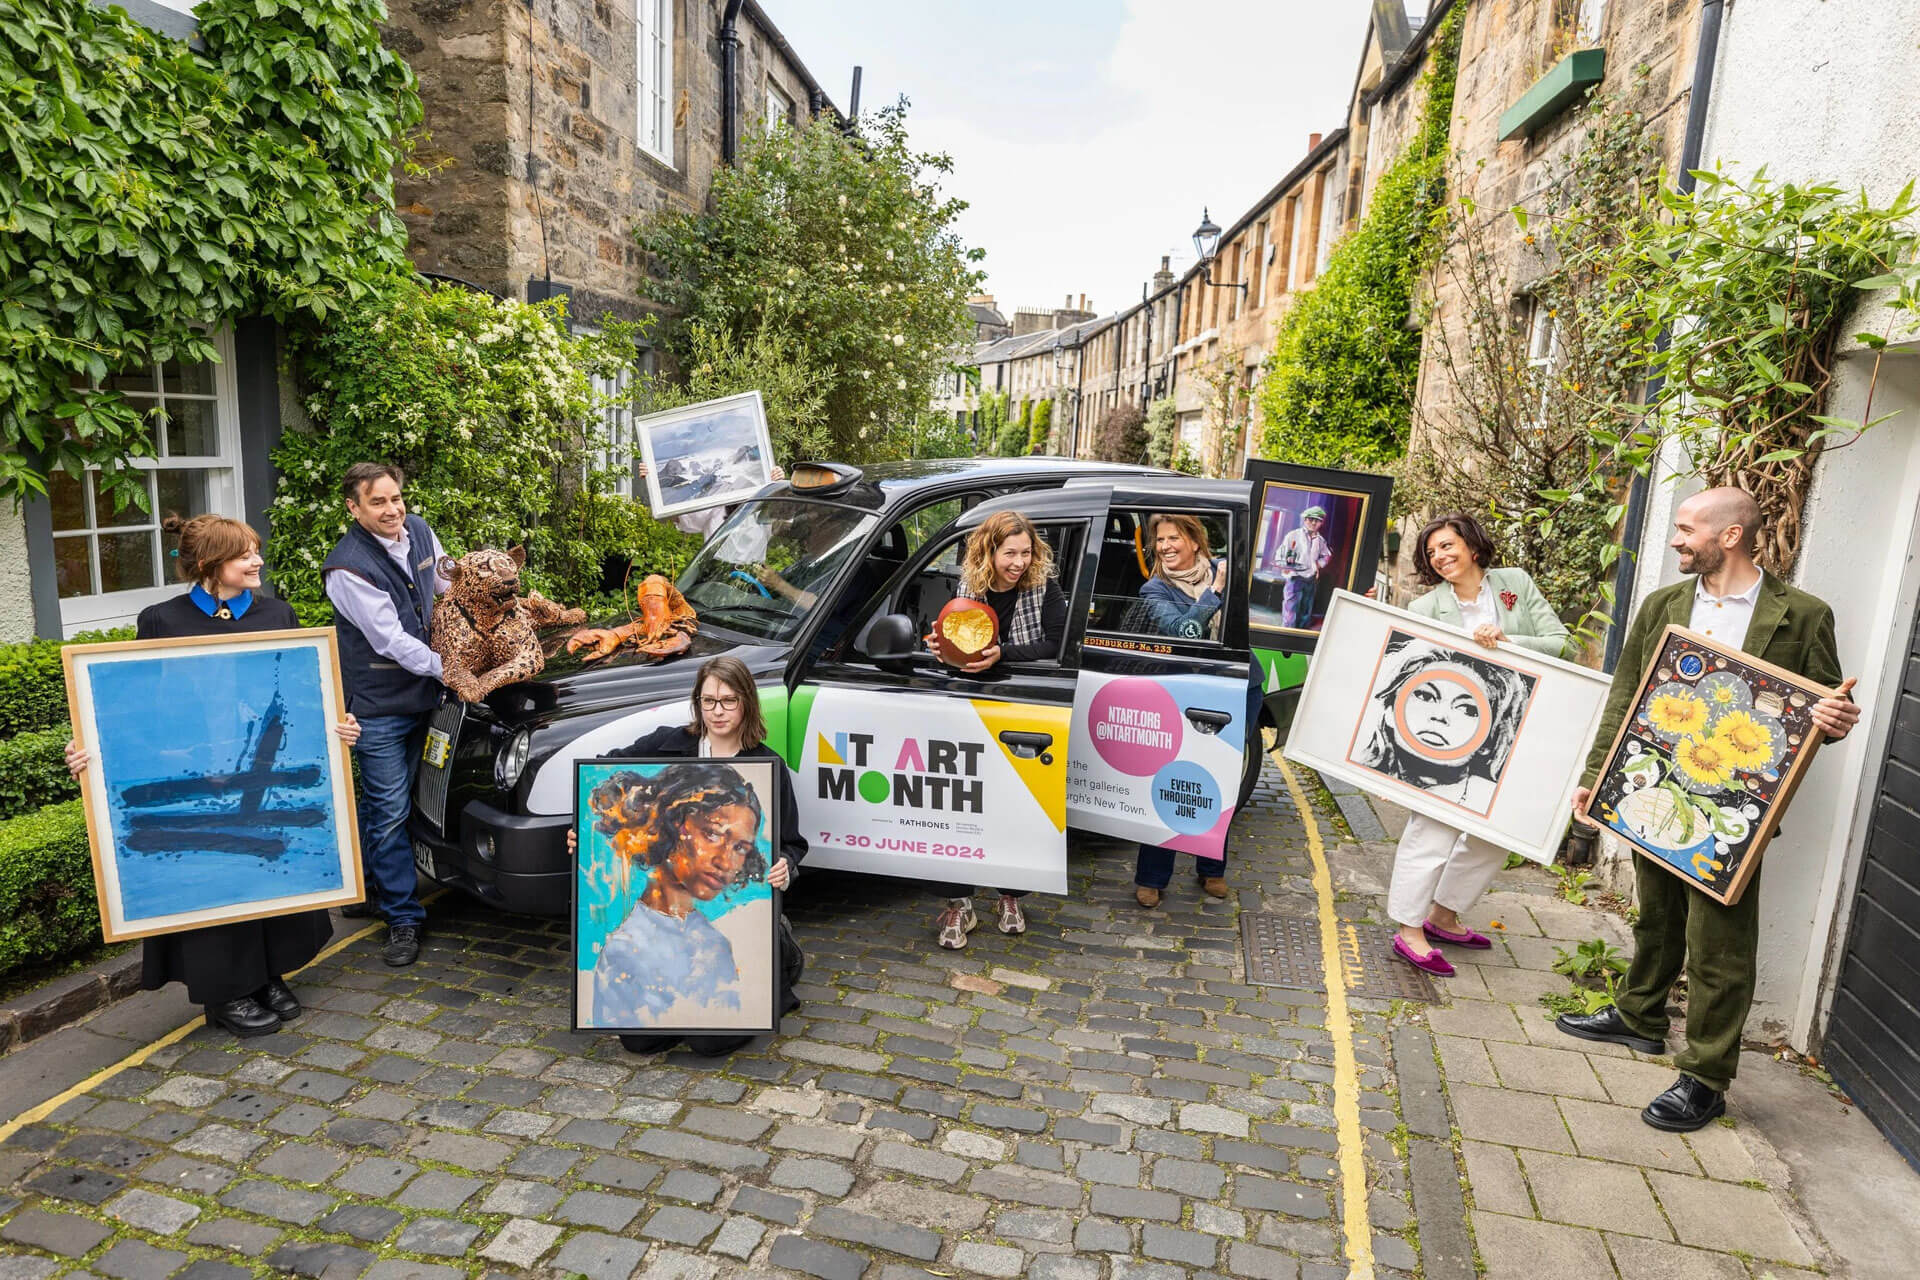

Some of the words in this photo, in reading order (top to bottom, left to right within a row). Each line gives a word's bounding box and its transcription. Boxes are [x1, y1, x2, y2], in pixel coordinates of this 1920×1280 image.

[1108, 705, 1161, 730] NTART.ORG
[1096, 721, 1173, 750] @NTARTMONTH
[817, 730, 874, 767] NT
[894, 738, 985, 777] ART
[1073, 760, 1088, 771] the
[817, 767, 984, 815] MONTH
[1074, 777, 1087, 788] art
[1090, 781, 1130, 796] galleries
[1170, 778, 1202, 795] EVENTS
[1094, 796, 1117, 809] New
[1120, 801, 1147, 816] Town.
[1159, 789, 1214, 810] THROUGHOUT
[1175, 804, 1197, 820] JUNE
[899, 818, 951, 831] RATHBONES
[819, 832, 832, 844] 7
[845, 834, 871, 848] 30
[875, 838, 928, 854] JUNE
[932, 843, 986, 860] 2024
